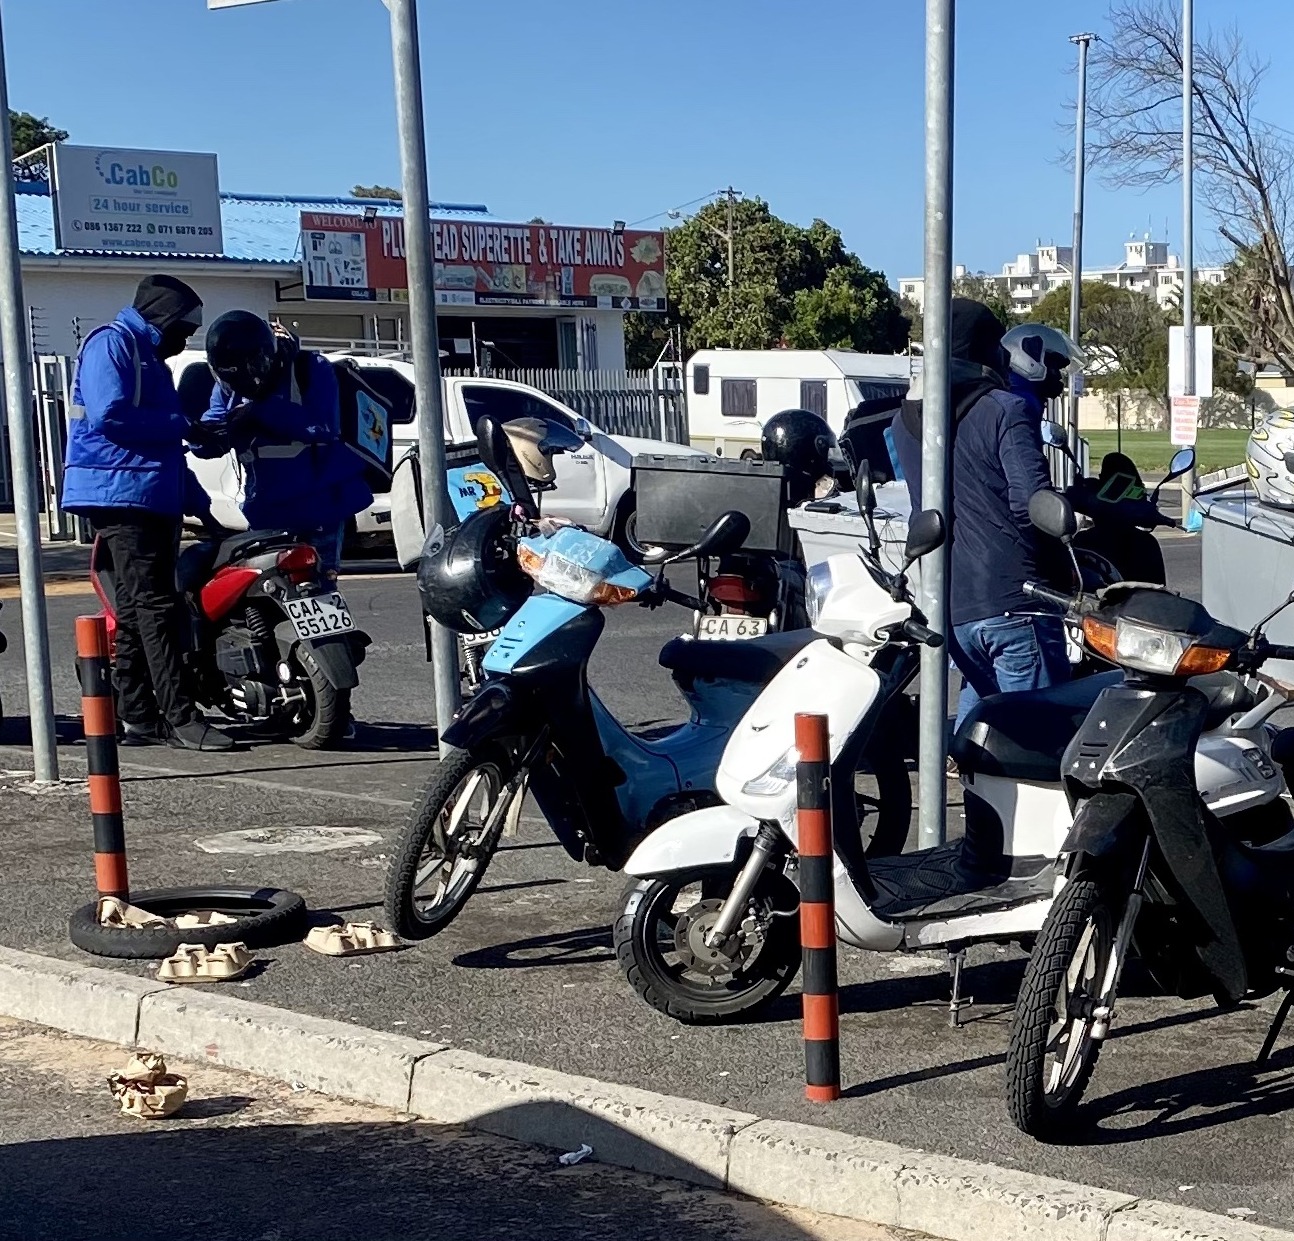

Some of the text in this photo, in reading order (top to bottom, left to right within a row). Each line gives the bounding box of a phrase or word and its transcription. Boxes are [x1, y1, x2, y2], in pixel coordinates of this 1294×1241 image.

[110, 162, 178, 189] CabCo
[94, 198, 189, 215] 24 hour service
[126, 223, 142, 233] 222
[158, 224, 173, 234] 071
[461, 224, 531, 264] SUPERETTE
[538, 228, 548, 264] &
[550, 229, 581, 267] TAKE
[584, 231, 625, 268] AWAYS
[459, 485, 477, 499] MR
[288, 598, 323, 620] CAA
[296, 611, 352, 637] 55126
[707, 619, 760, 636] CA 63
